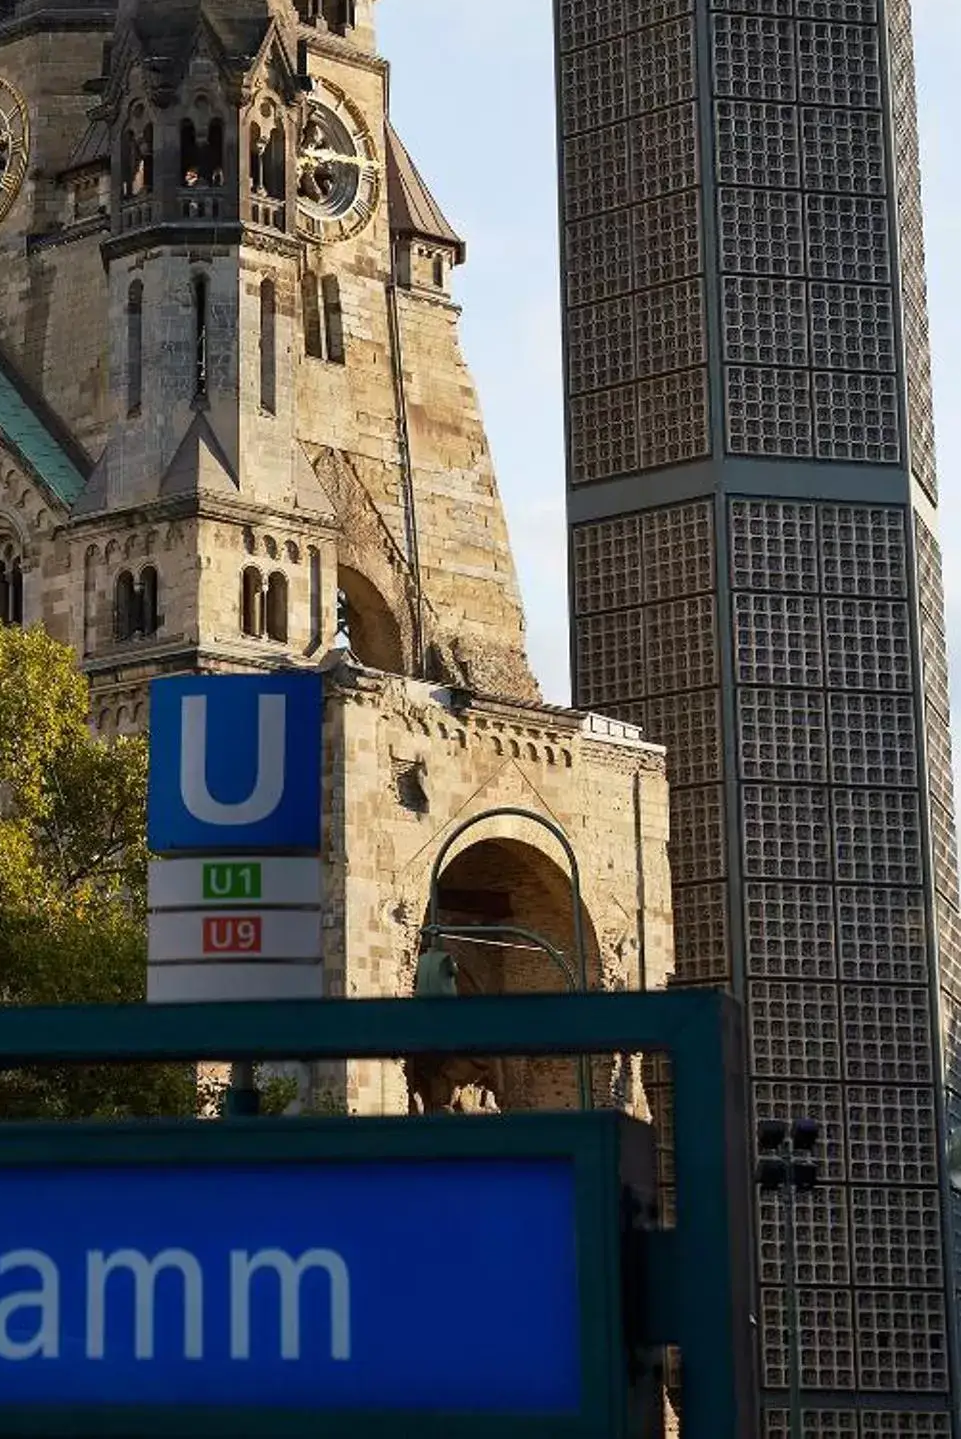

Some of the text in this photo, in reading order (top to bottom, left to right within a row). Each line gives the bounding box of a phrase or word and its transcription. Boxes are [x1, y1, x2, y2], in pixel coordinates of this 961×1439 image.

[179, 693, 286, 826] U
[209, 868, 253, 895] U1
[209, 922, 256, 949] U9
